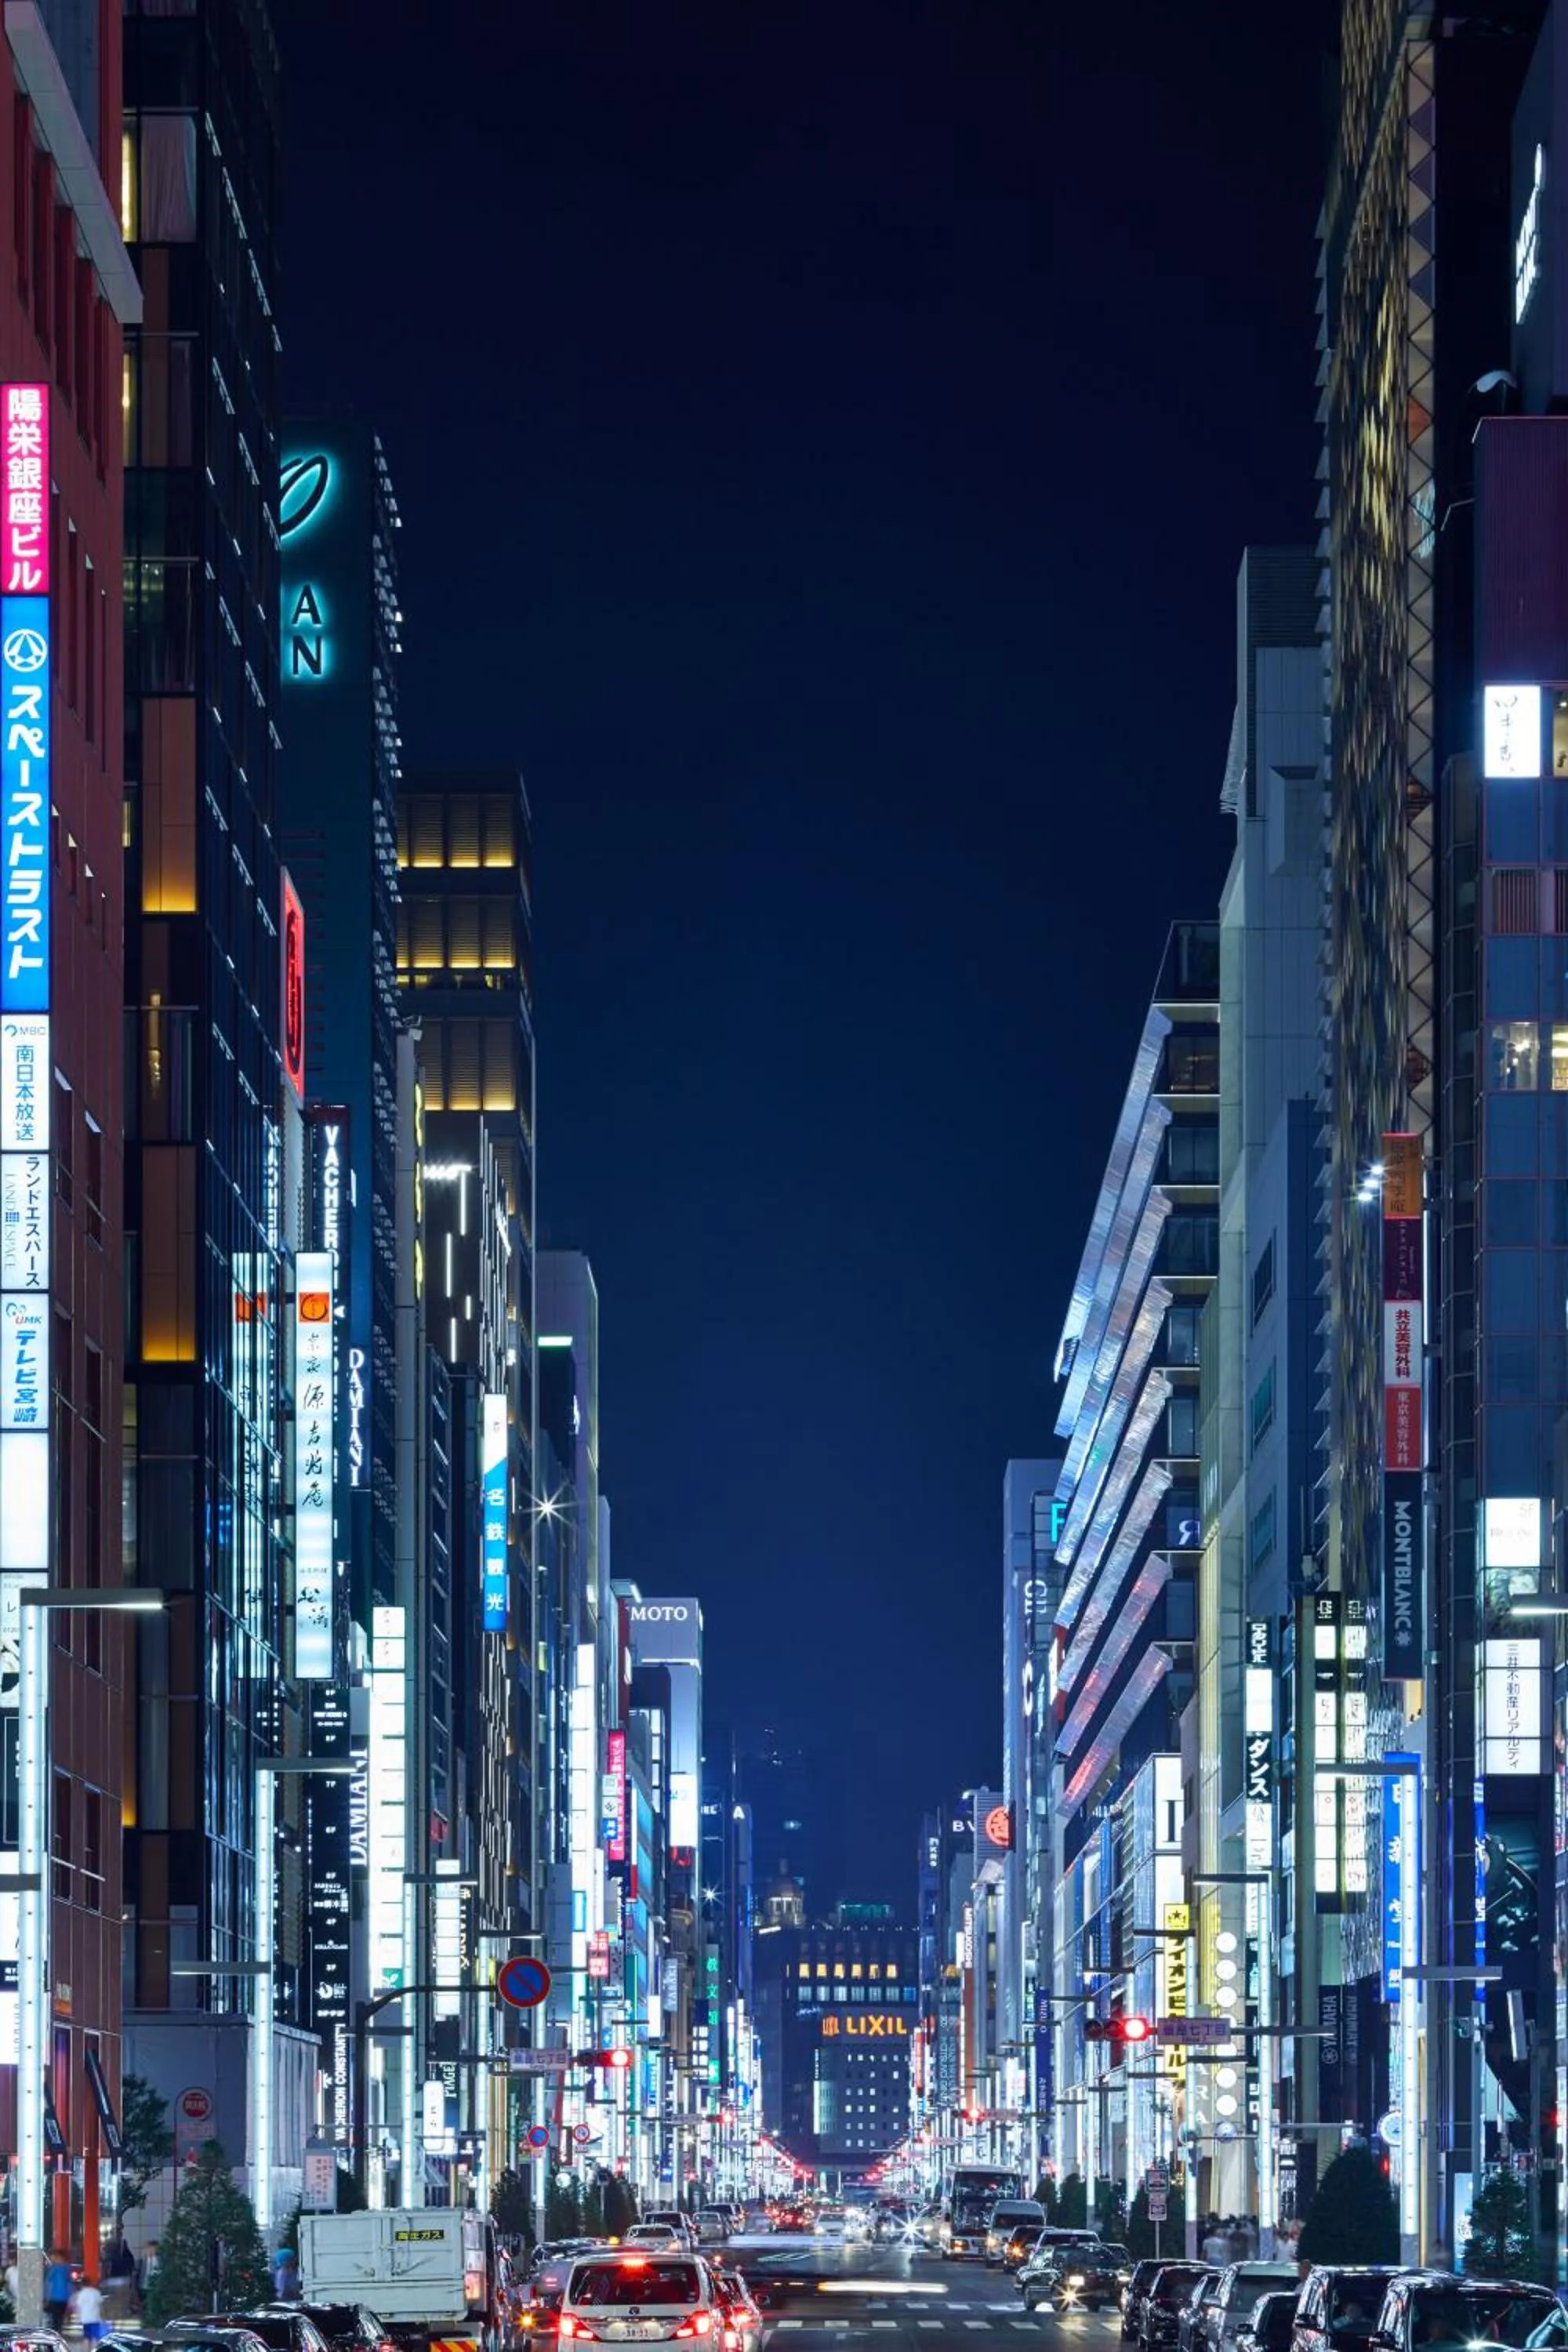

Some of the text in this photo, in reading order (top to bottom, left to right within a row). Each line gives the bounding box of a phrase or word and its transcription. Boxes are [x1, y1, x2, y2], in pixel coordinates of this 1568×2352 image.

[7, 387, 42, 590] 陽栄銀座ビル
[7, 685, 44, 978] スペーストラスト
[20, 1025, 46, 1036] MBC
[15, 1044, 35, 1142] 南日本放送
[25, 1156, 41, 1287] ランドエスパース
[15, 1316, 42, 1325] UMK
[1395, 1308, 1411, 1379] 共立美容外科
[13, 1330, 38, 1423] テレビ宮崎
[349, 1348, 365, 1486] DAMIANI
[1396, 1391, 1411, 1465] 東京美容外科
[1392, 1501, 1412, 1628] MONTBLANC
[630, 1606, 688, 1621] MOTO
[1506, 1643, 1520, 1769] 三井不動産リアルティ
[1248, 1737, 1270, 1797] ダンス
[335, 2024, 347, 2085] CONSTANT
[846, 2015, 907, 2035] LIXIL
